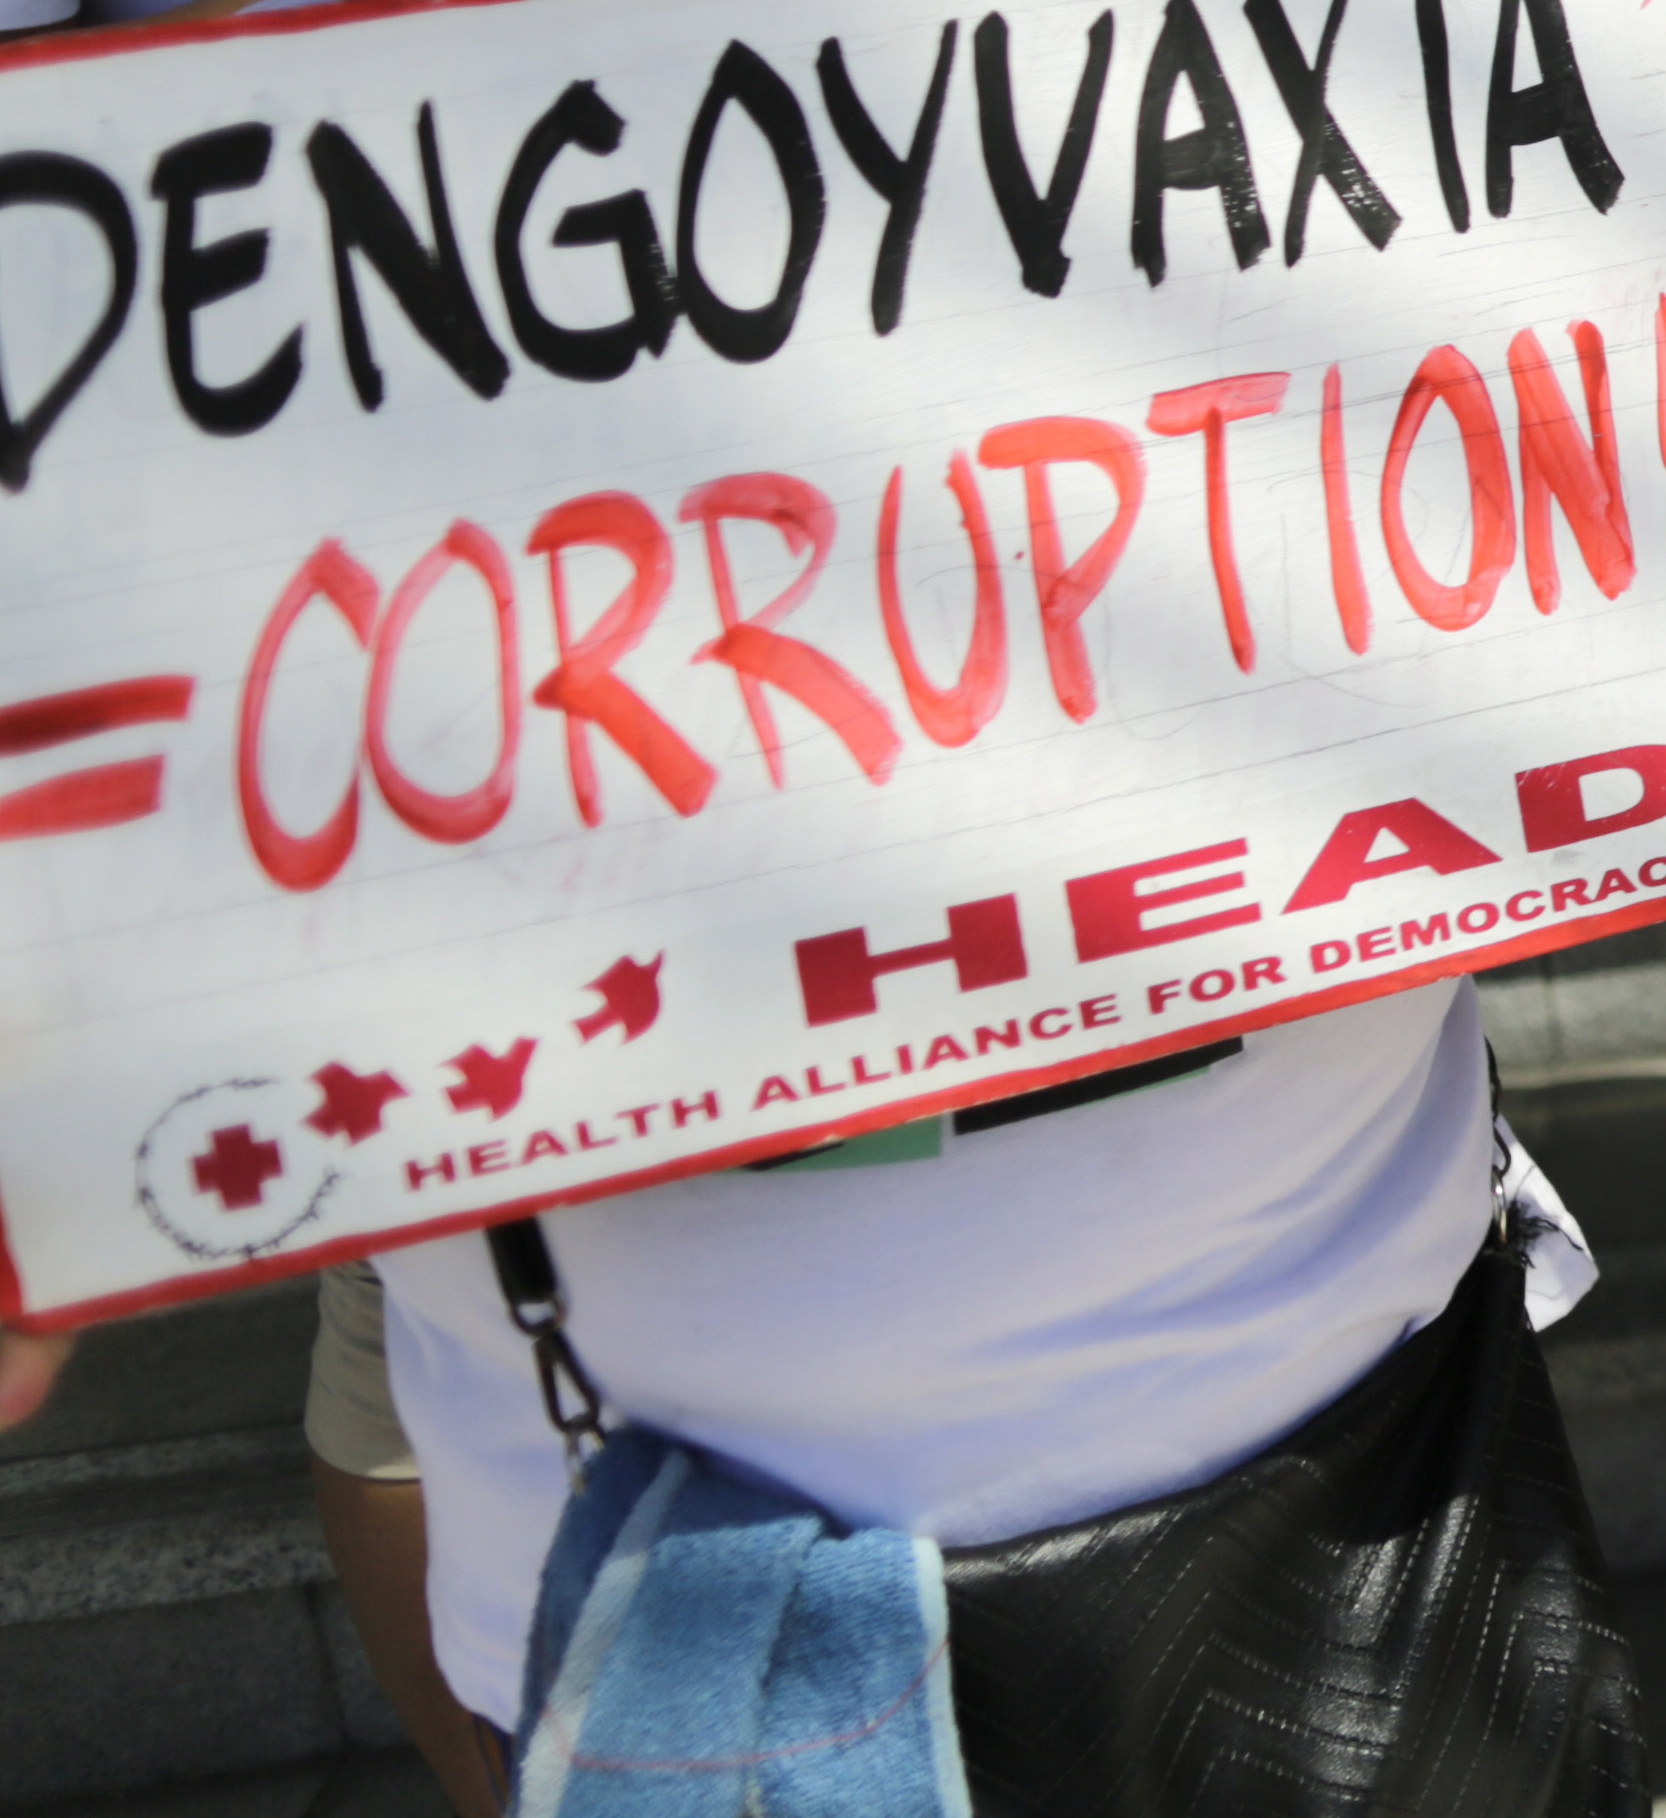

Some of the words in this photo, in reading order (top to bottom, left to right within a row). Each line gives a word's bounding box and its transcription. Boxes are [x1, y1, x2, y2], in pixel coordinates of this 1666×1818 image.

[405, 1090, 722, 1192] HEALTH
[749, 993, 1123, 1112] ALLIANCE
[1146, 955, 1287, 1017] FOR
